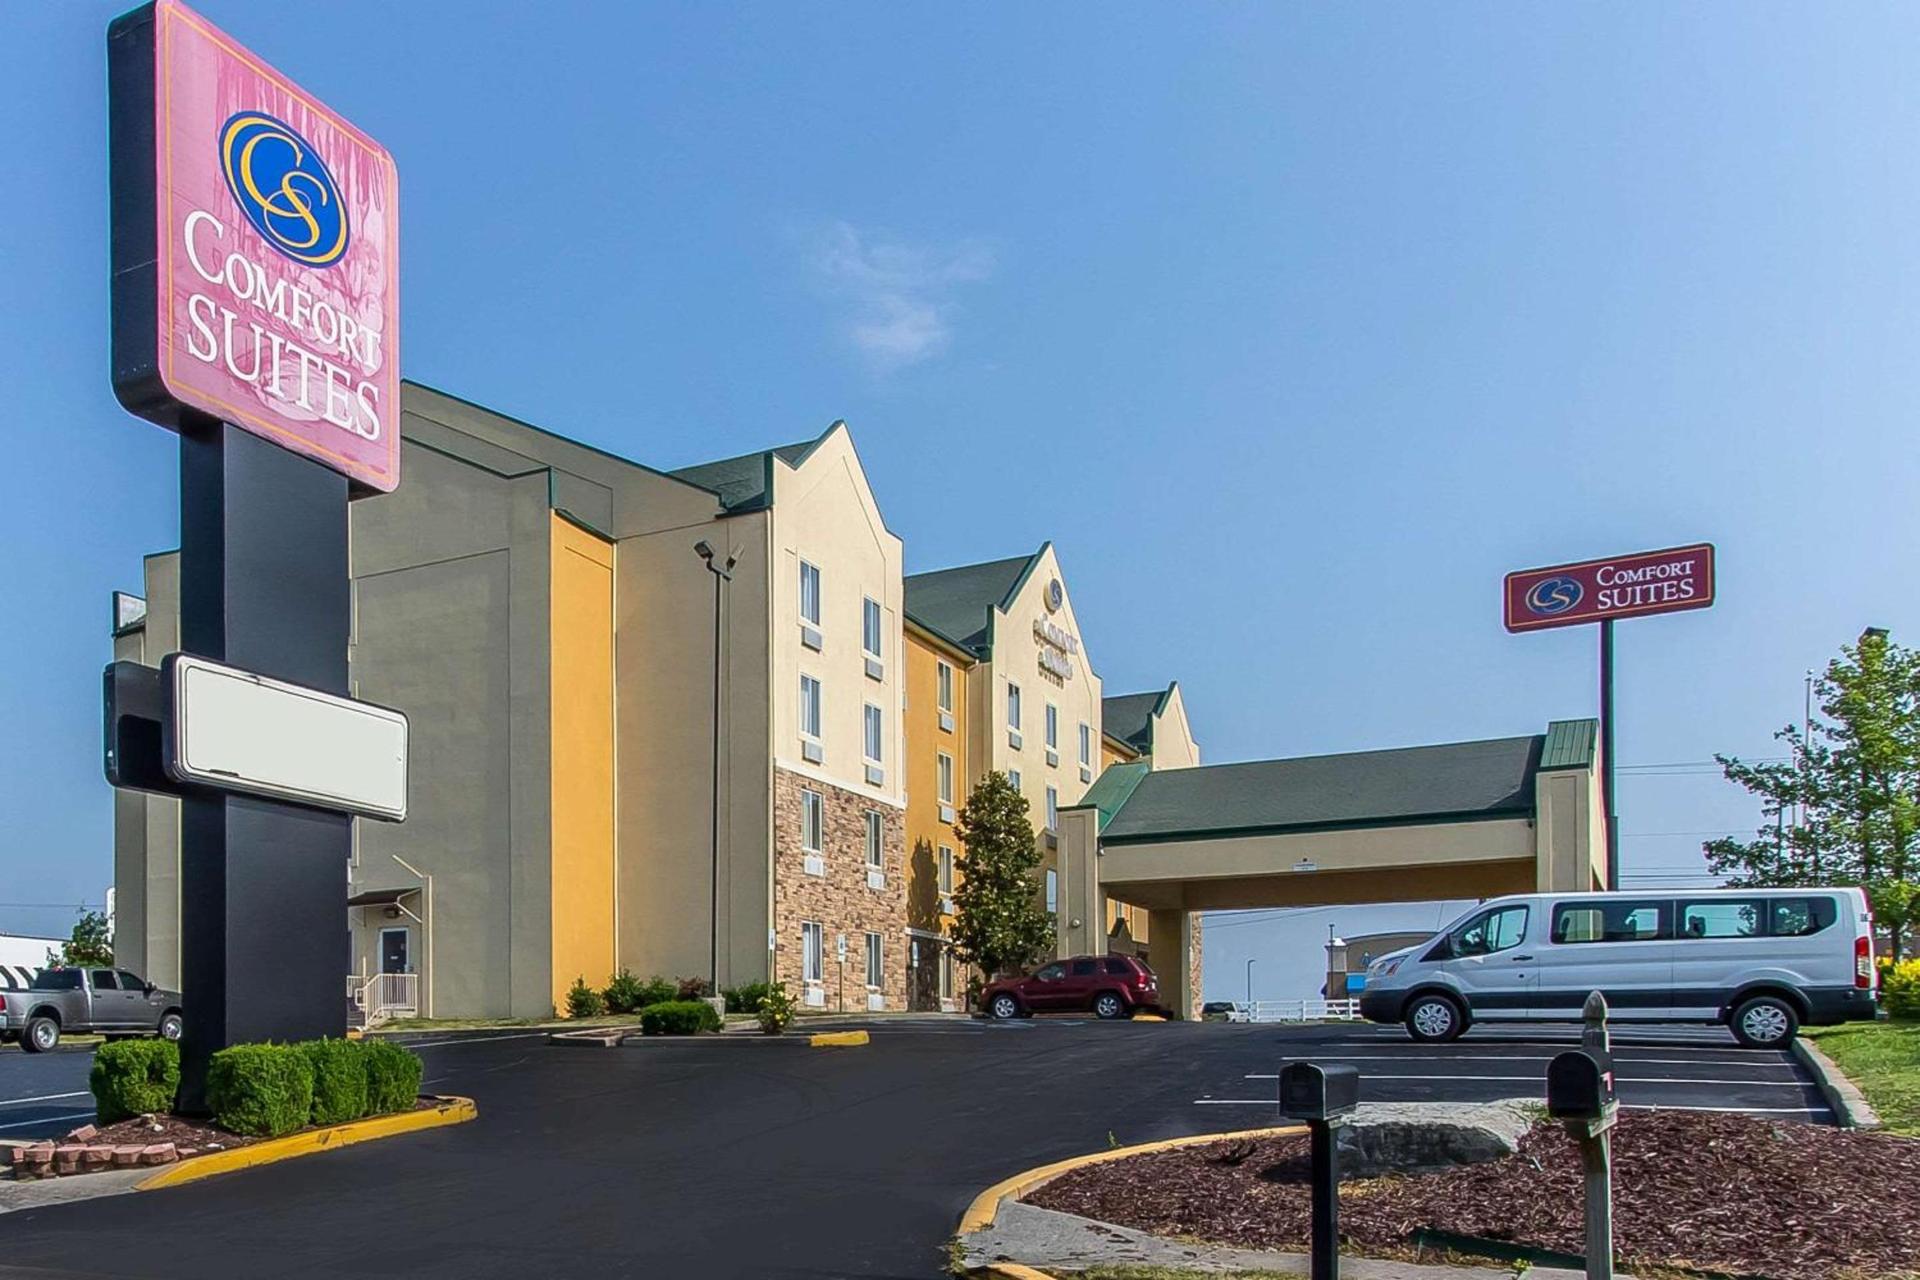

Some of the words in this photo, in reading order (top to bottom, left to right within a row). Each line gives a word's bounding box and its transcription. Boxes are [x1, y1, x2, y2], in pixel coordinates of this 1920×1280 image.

[183, 210, 381, 377] COMFORT
[187, 294, 381, 441] SUITES
[1596, 560, 1695, 586] COMFORT
[1597, 578, 1694, 609] SUITES
